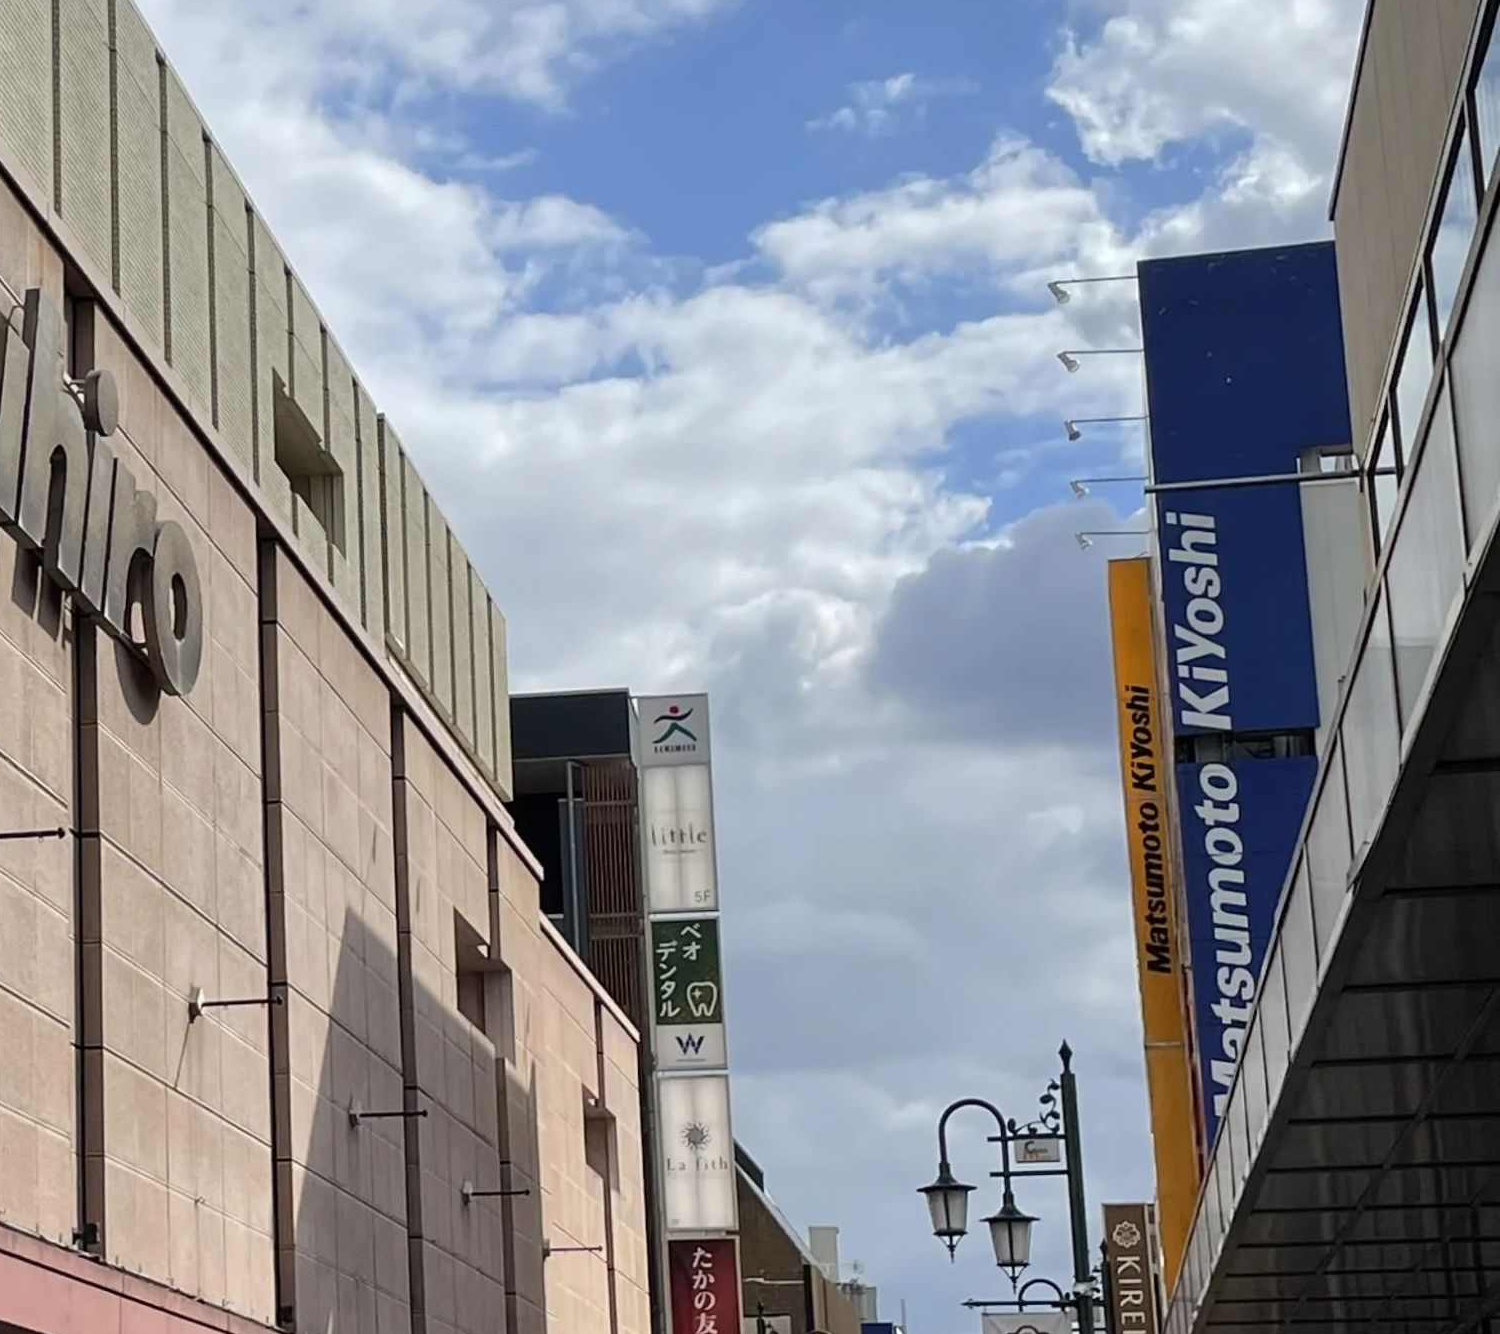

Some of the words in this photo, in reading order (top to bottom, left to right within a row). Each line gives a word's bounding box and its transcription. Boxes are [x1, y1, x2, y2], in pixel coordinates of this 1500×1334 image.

[1166, 511, 1232, 731] KiYoshi
[650, 822, 707, 846] little
[694, 890, 712, 903] 5F
[1138, 801, 1171, 974] Matsumoto
[680, 922, 702, 961] ベオ
[656, 940, 681, 1017] デンタル
